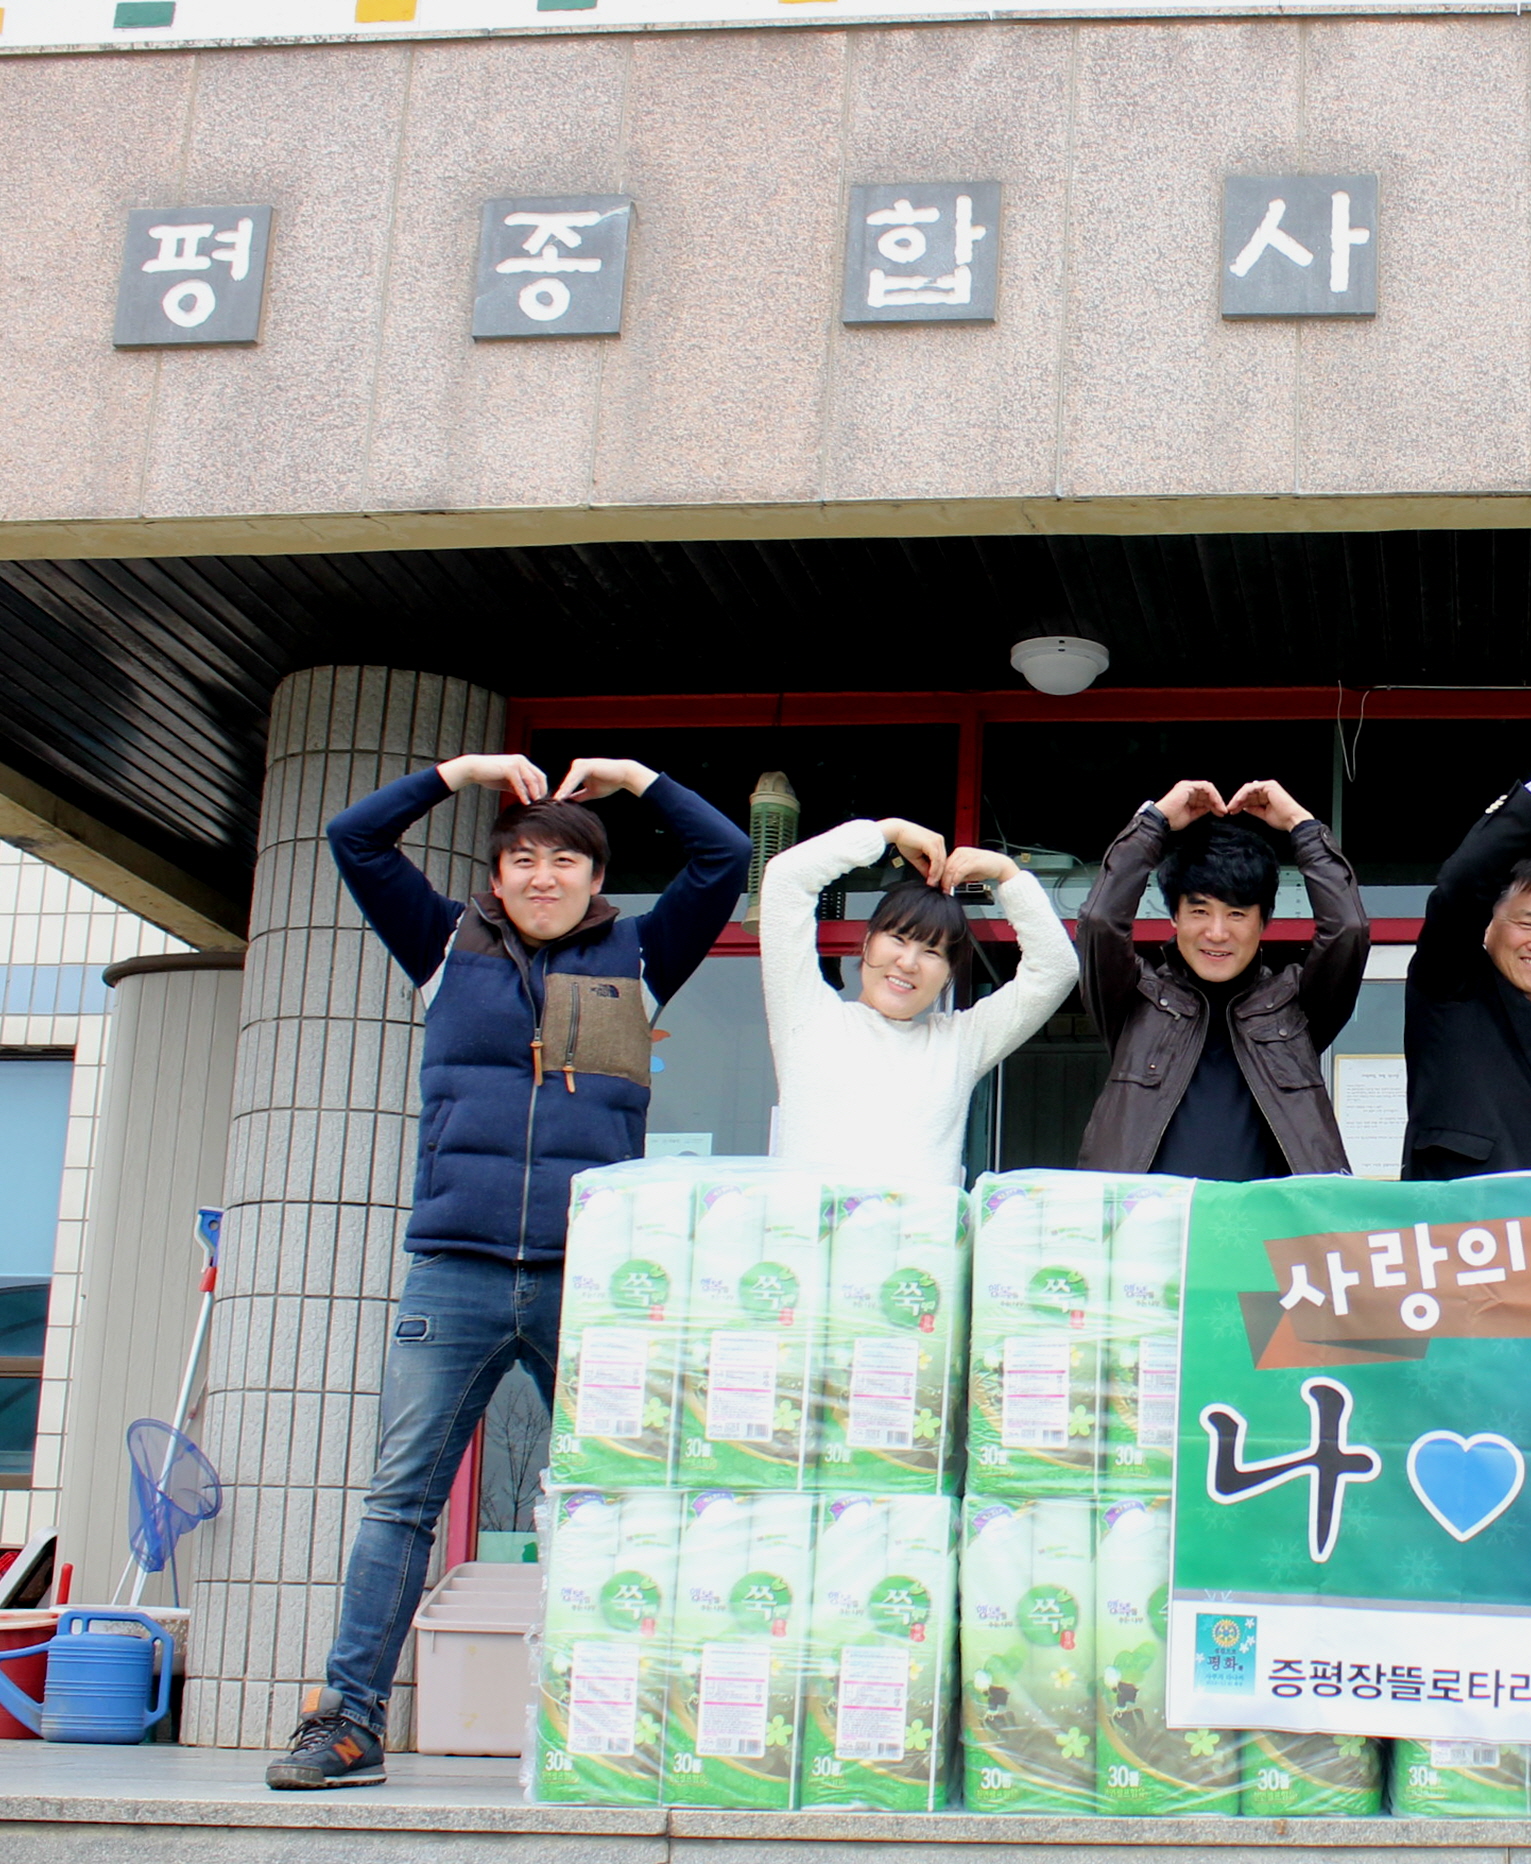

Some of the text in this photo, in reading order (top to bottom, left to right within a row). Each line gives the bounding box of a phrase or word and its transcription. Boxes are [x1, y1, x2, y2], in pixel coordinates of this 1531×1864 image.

[620, 1274, 655, 1306] 쑥
[750, 1277, 784, 1308] 쑥
[1280, 1220, 1527, 1332] 사랑의
[891, 1281, 925, 1316] 쑥
[612, 1585, 647, 1619] 쑥
[741, 1585, 776, 1620] 쑥
[881, 1589, 916, 1623] 쑥
[1028, 1598, 1064, 1633] 쑥
